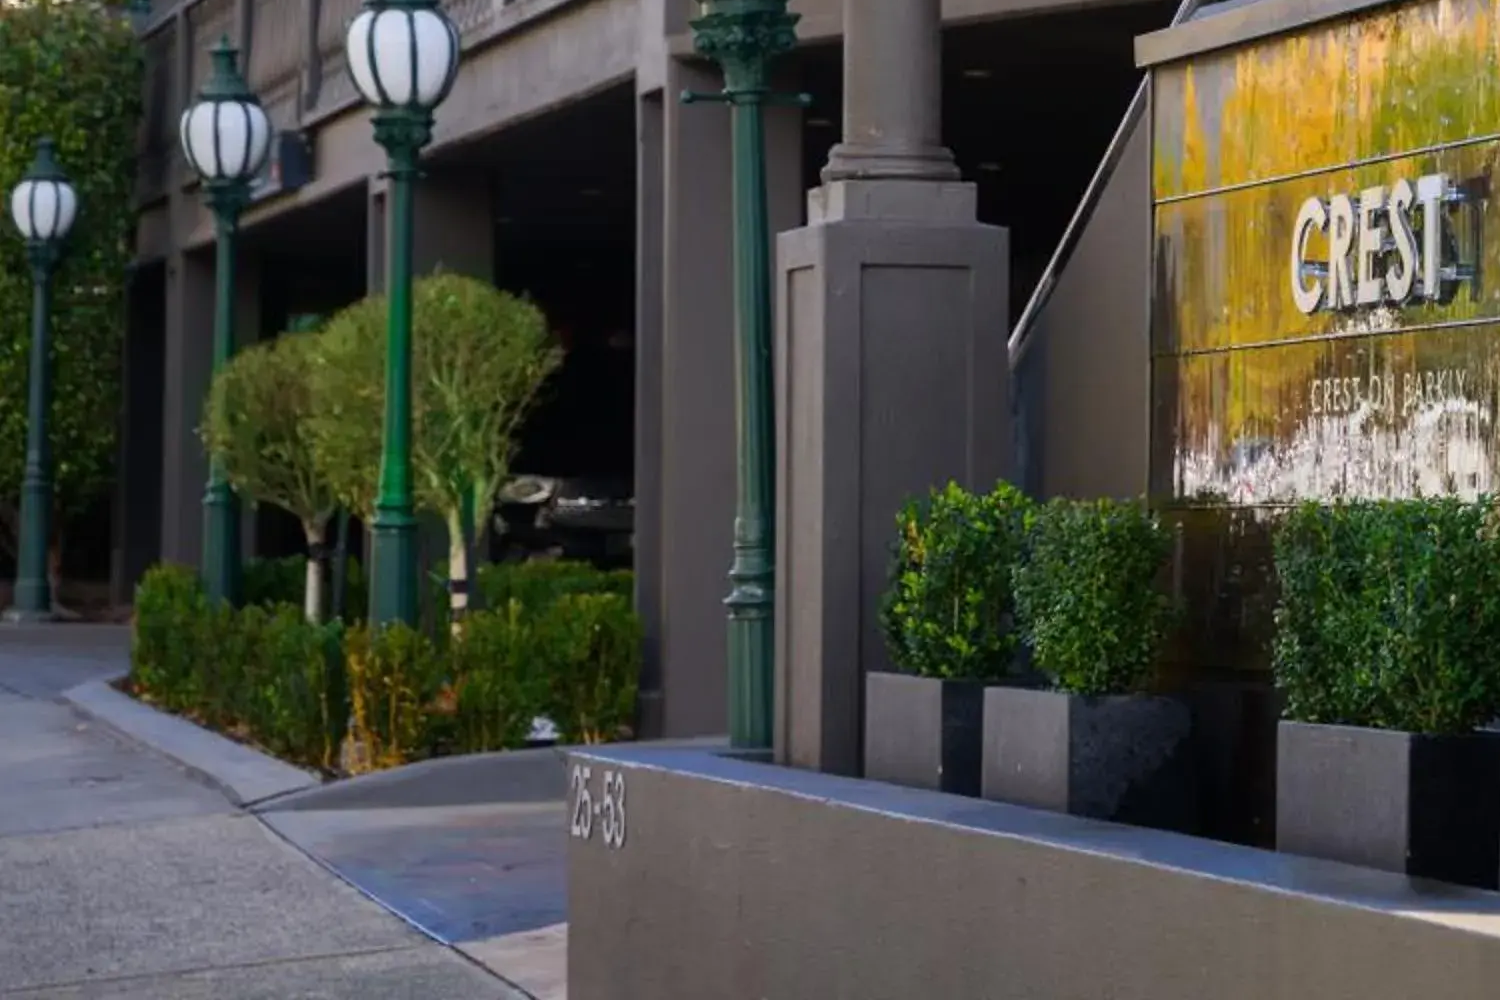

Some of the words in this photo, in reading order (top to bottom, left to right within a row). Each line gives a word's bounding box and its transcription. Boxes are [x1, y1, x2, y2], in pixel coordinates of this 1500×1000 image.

[1291, 173, 1447, 314] CREST
[1311, 377, 1360, 412] CREST
[1368, 374, 1394, 409] ON
[571, 764, 624, 848] 25-53
